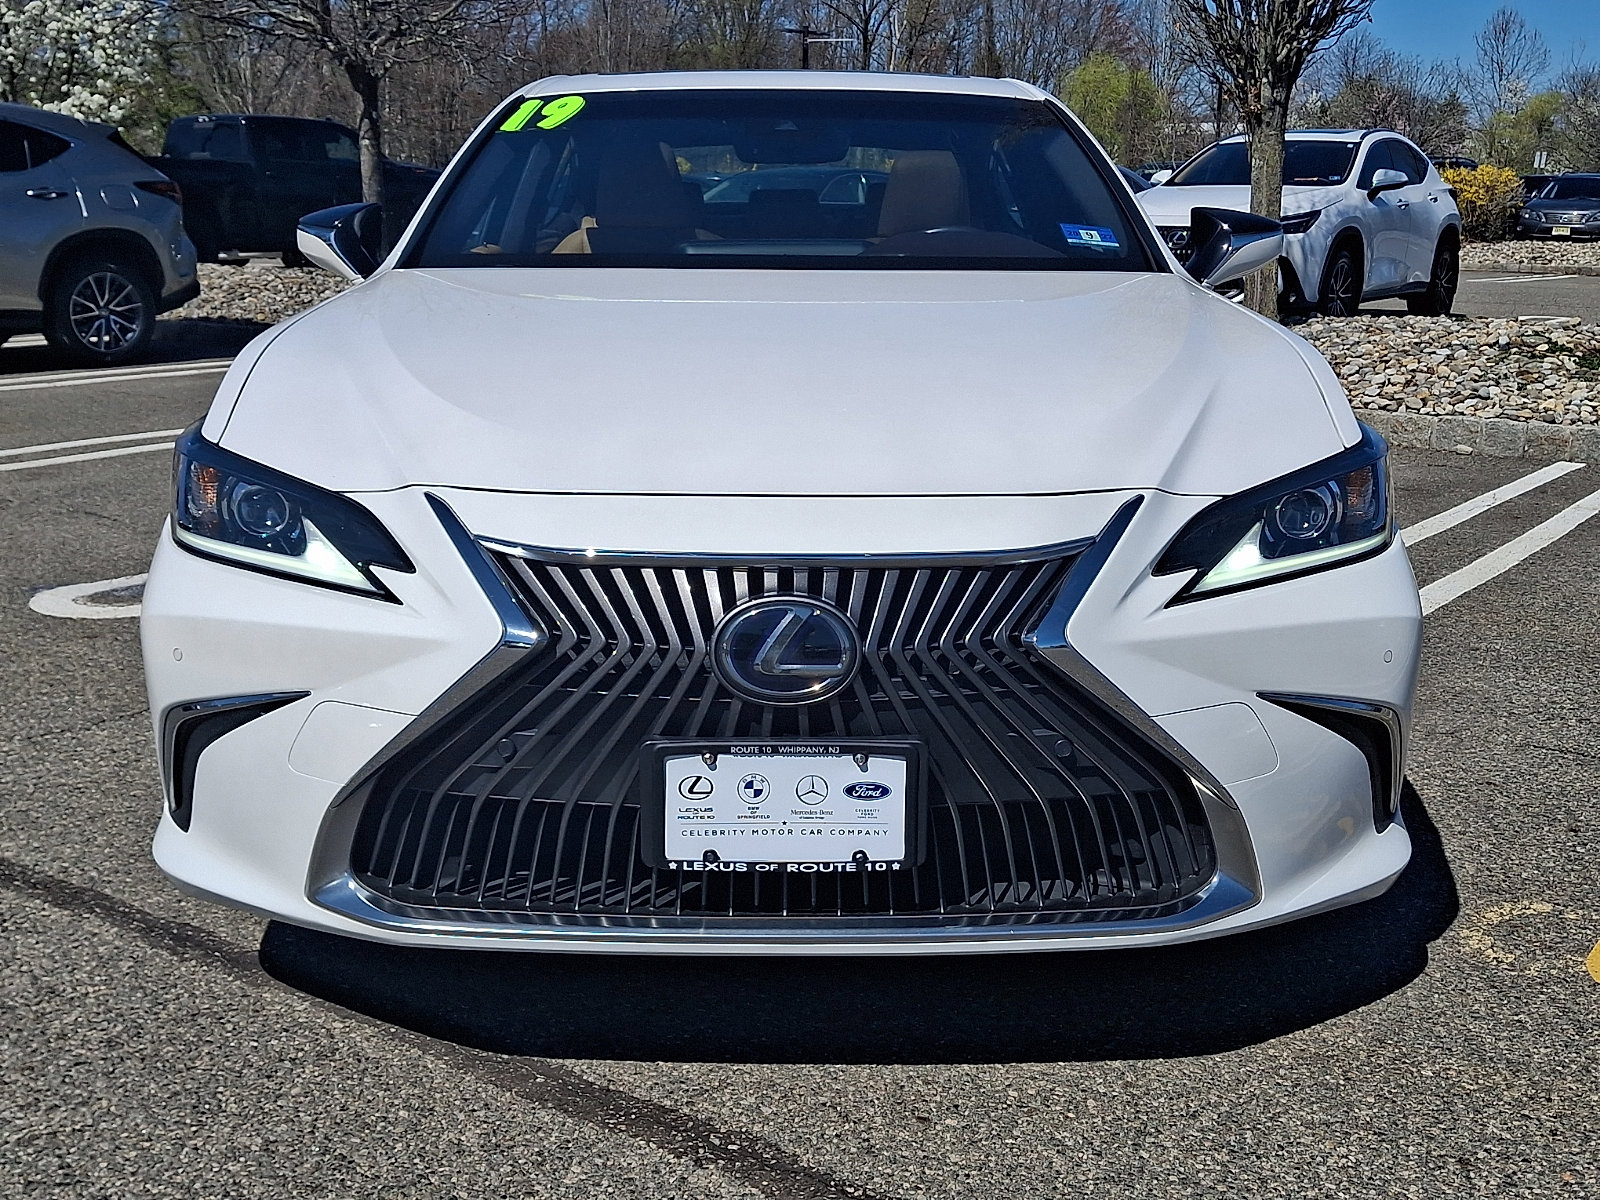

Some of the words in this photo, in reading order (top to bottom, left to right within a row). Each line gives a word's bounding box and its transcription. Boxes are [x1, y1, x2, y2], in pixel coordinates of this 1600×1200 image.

[499, 95, 586, 132] 19
[1085, 231, 1094, 239] 9
[730, 746, 760, 754] ROUTE
[762, 746, 772, 754] 10
[778, 746, 827, 754] WHIPPANY,
[828, 746, 840, 754] NJ
[852, 784, 882, 798] Ford
[681, 829, 746, 837] CELEBRITY
[751, 828, 794, 836] MOTOR
[800, 828, 823, 836] CAR
[829, 828, 889, 836] COMPANY
[682, 861, 748, 872] LEXUS
[755, 863, 779, 872] OF
[786, 862, 857, 873] ROUTE
[864, 862, 887, 872] 10
